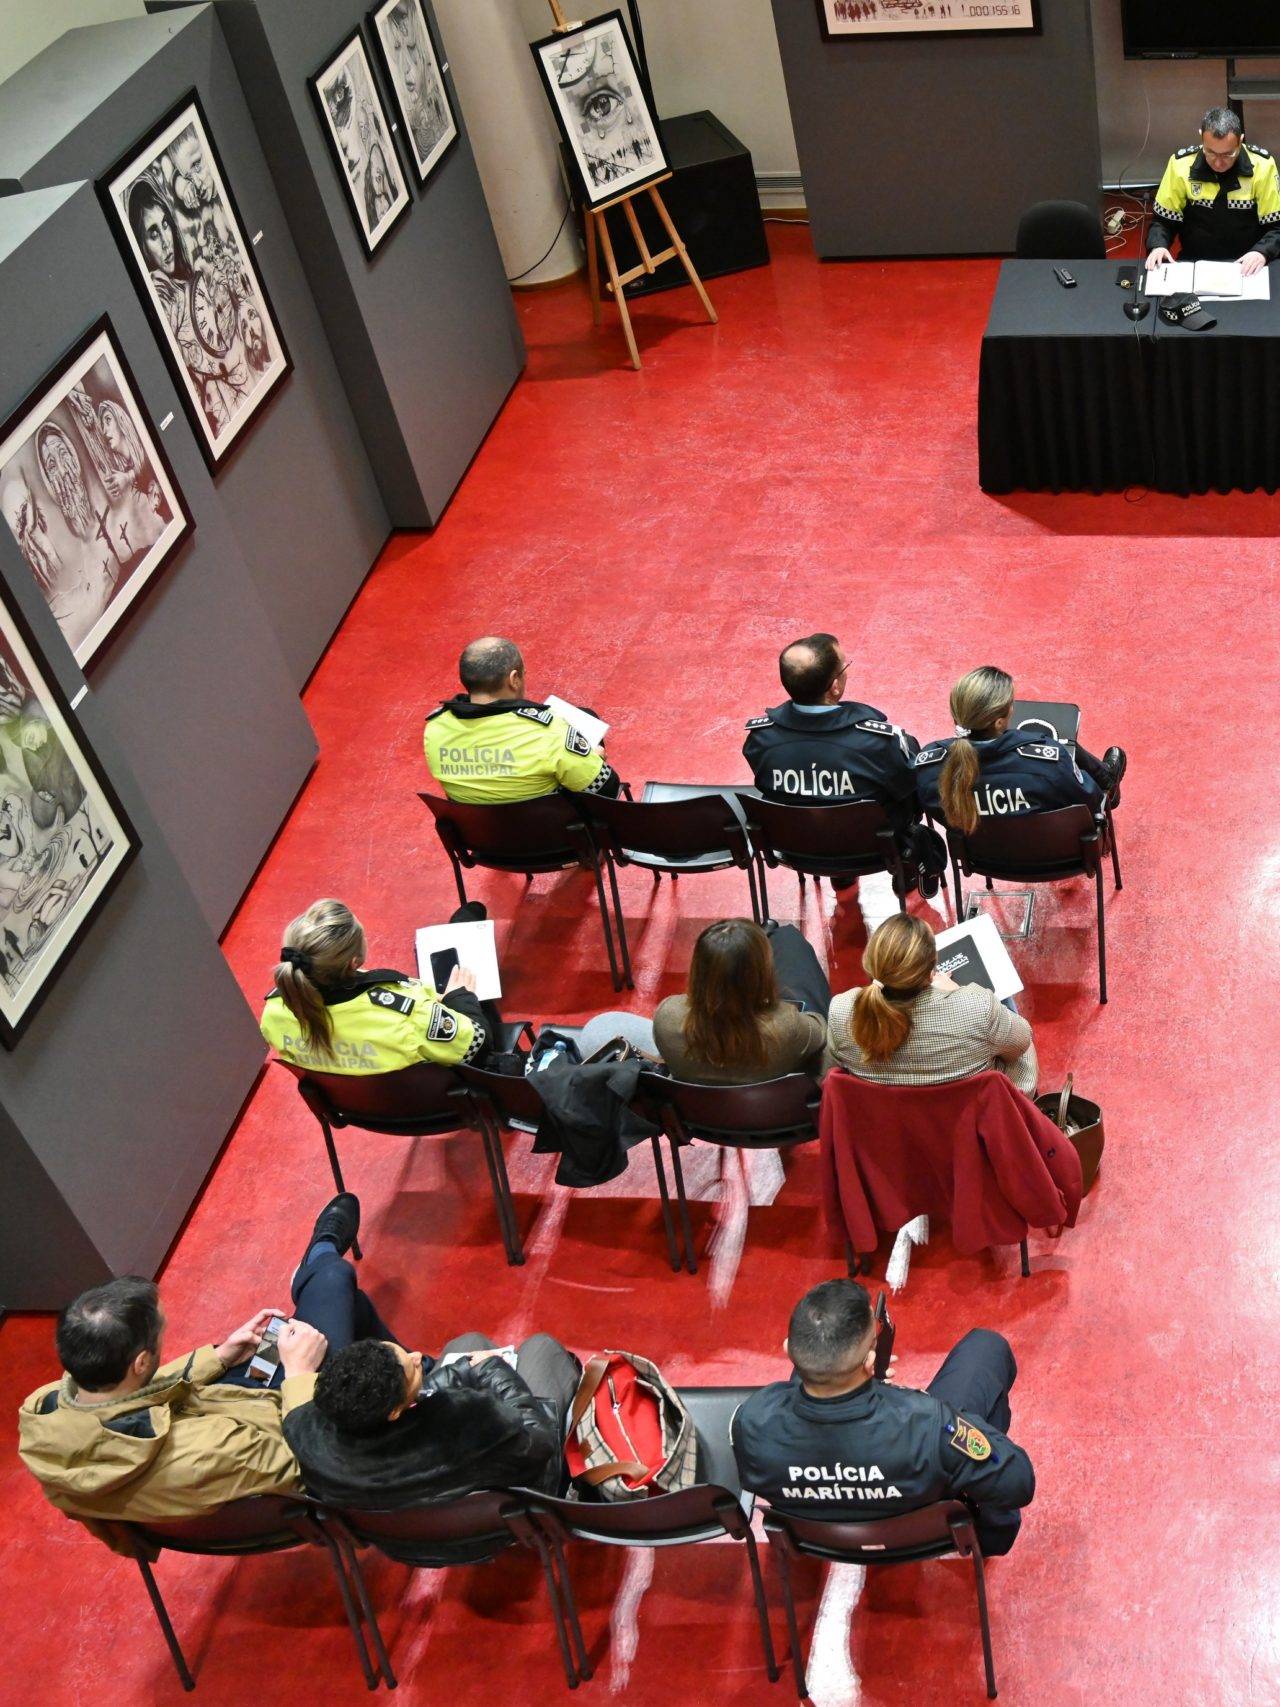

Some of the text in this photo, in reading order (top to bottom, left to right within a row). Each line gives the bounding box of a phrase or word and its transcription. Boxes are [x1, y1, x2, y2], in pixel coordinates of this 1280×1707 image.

[440, 763, 518, 776] MUNICIPAL
[772, 763, 856, 797] POLÍCIA
[973, 784, 1032, 816] LÍCIA
[283, 1034, 379, 1057] POCIA
[788, 1462, 885, 1482] POLÍCIA
[782, 1483, 903, 1500] MARÍTIMA
